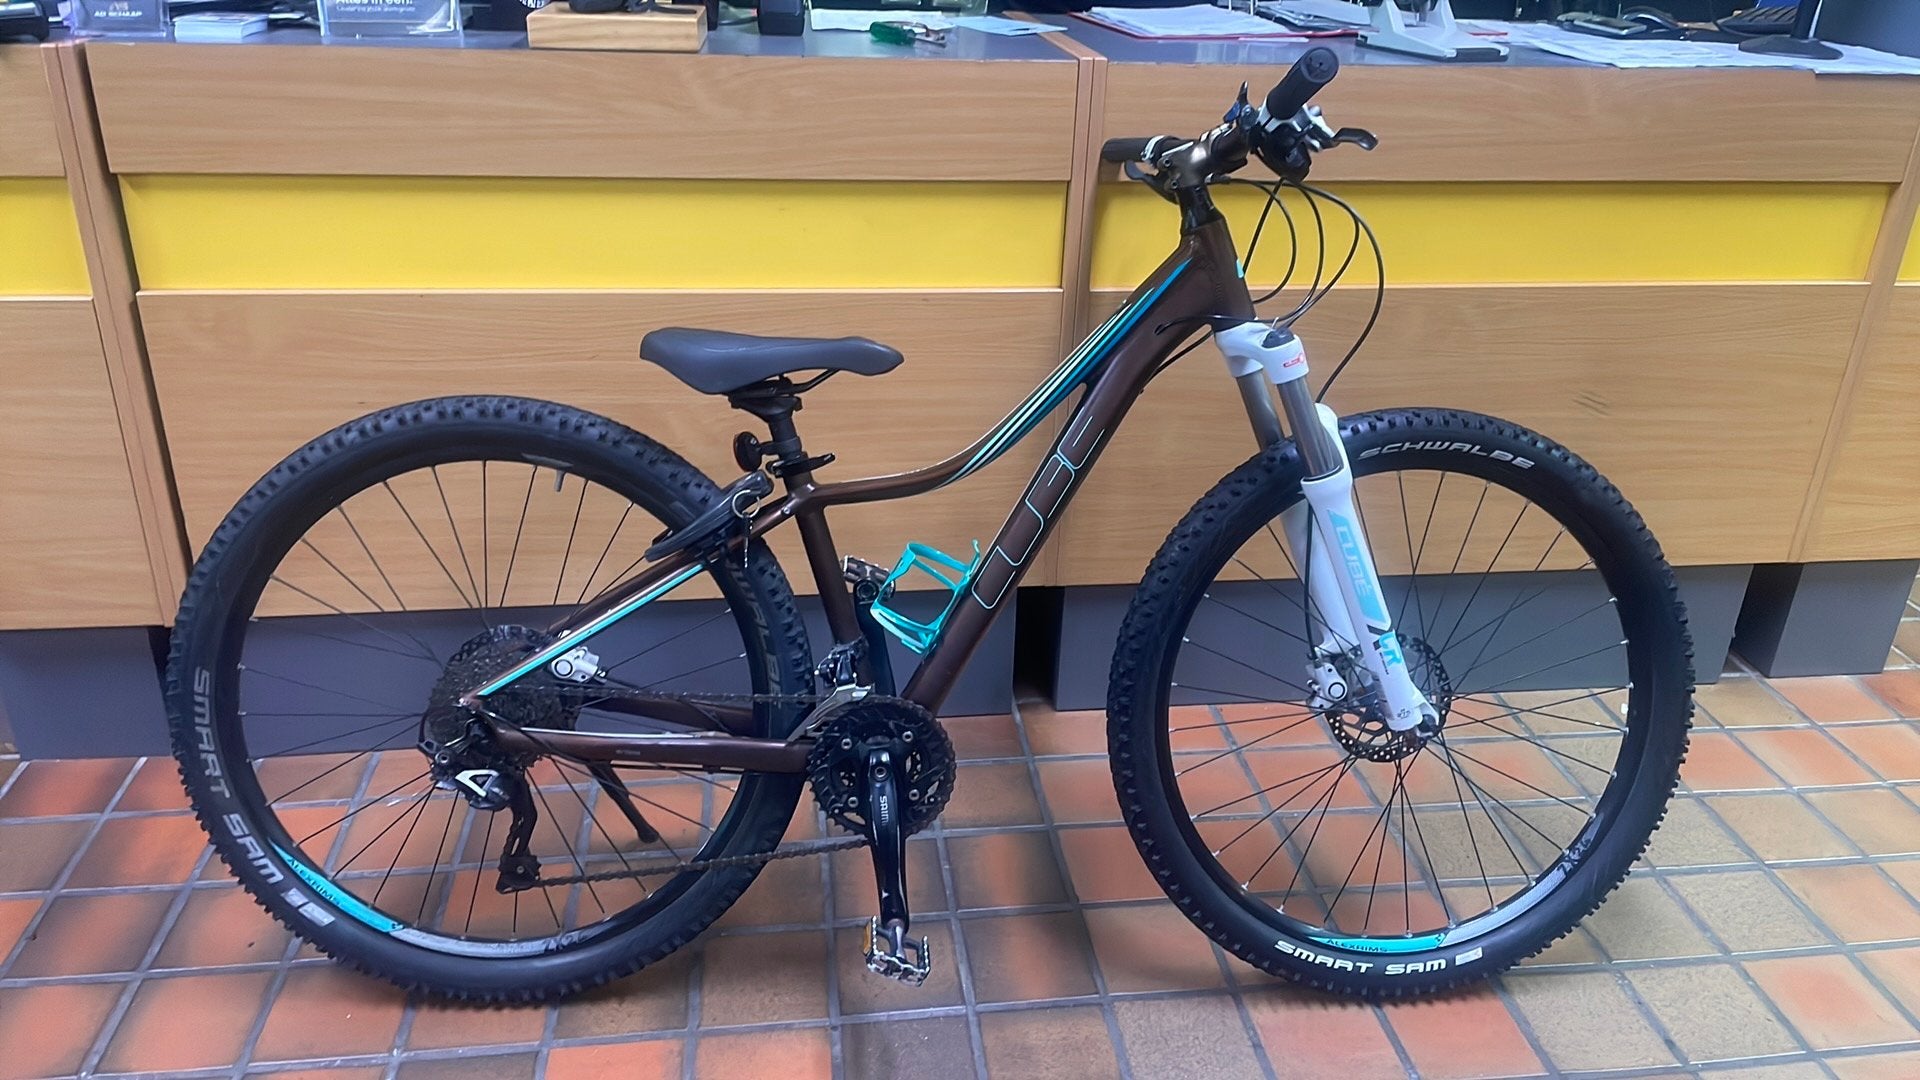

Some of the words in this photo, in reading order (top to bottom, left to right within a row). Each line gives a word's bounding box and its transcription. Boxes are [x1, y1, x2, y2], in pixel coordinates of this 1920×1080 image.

[1358, 440, 1535, 470] SCHWALBE
[971, 406, 1105, 609] CUBE
[1335, 526, 1368, 598] CUBE
[193, 666, 231, 799] SMART
[222, 813, 284, 885] SAM
[1274, 940, 1374, 974] SMART
[1384, 958, 1447, 976] SAM
